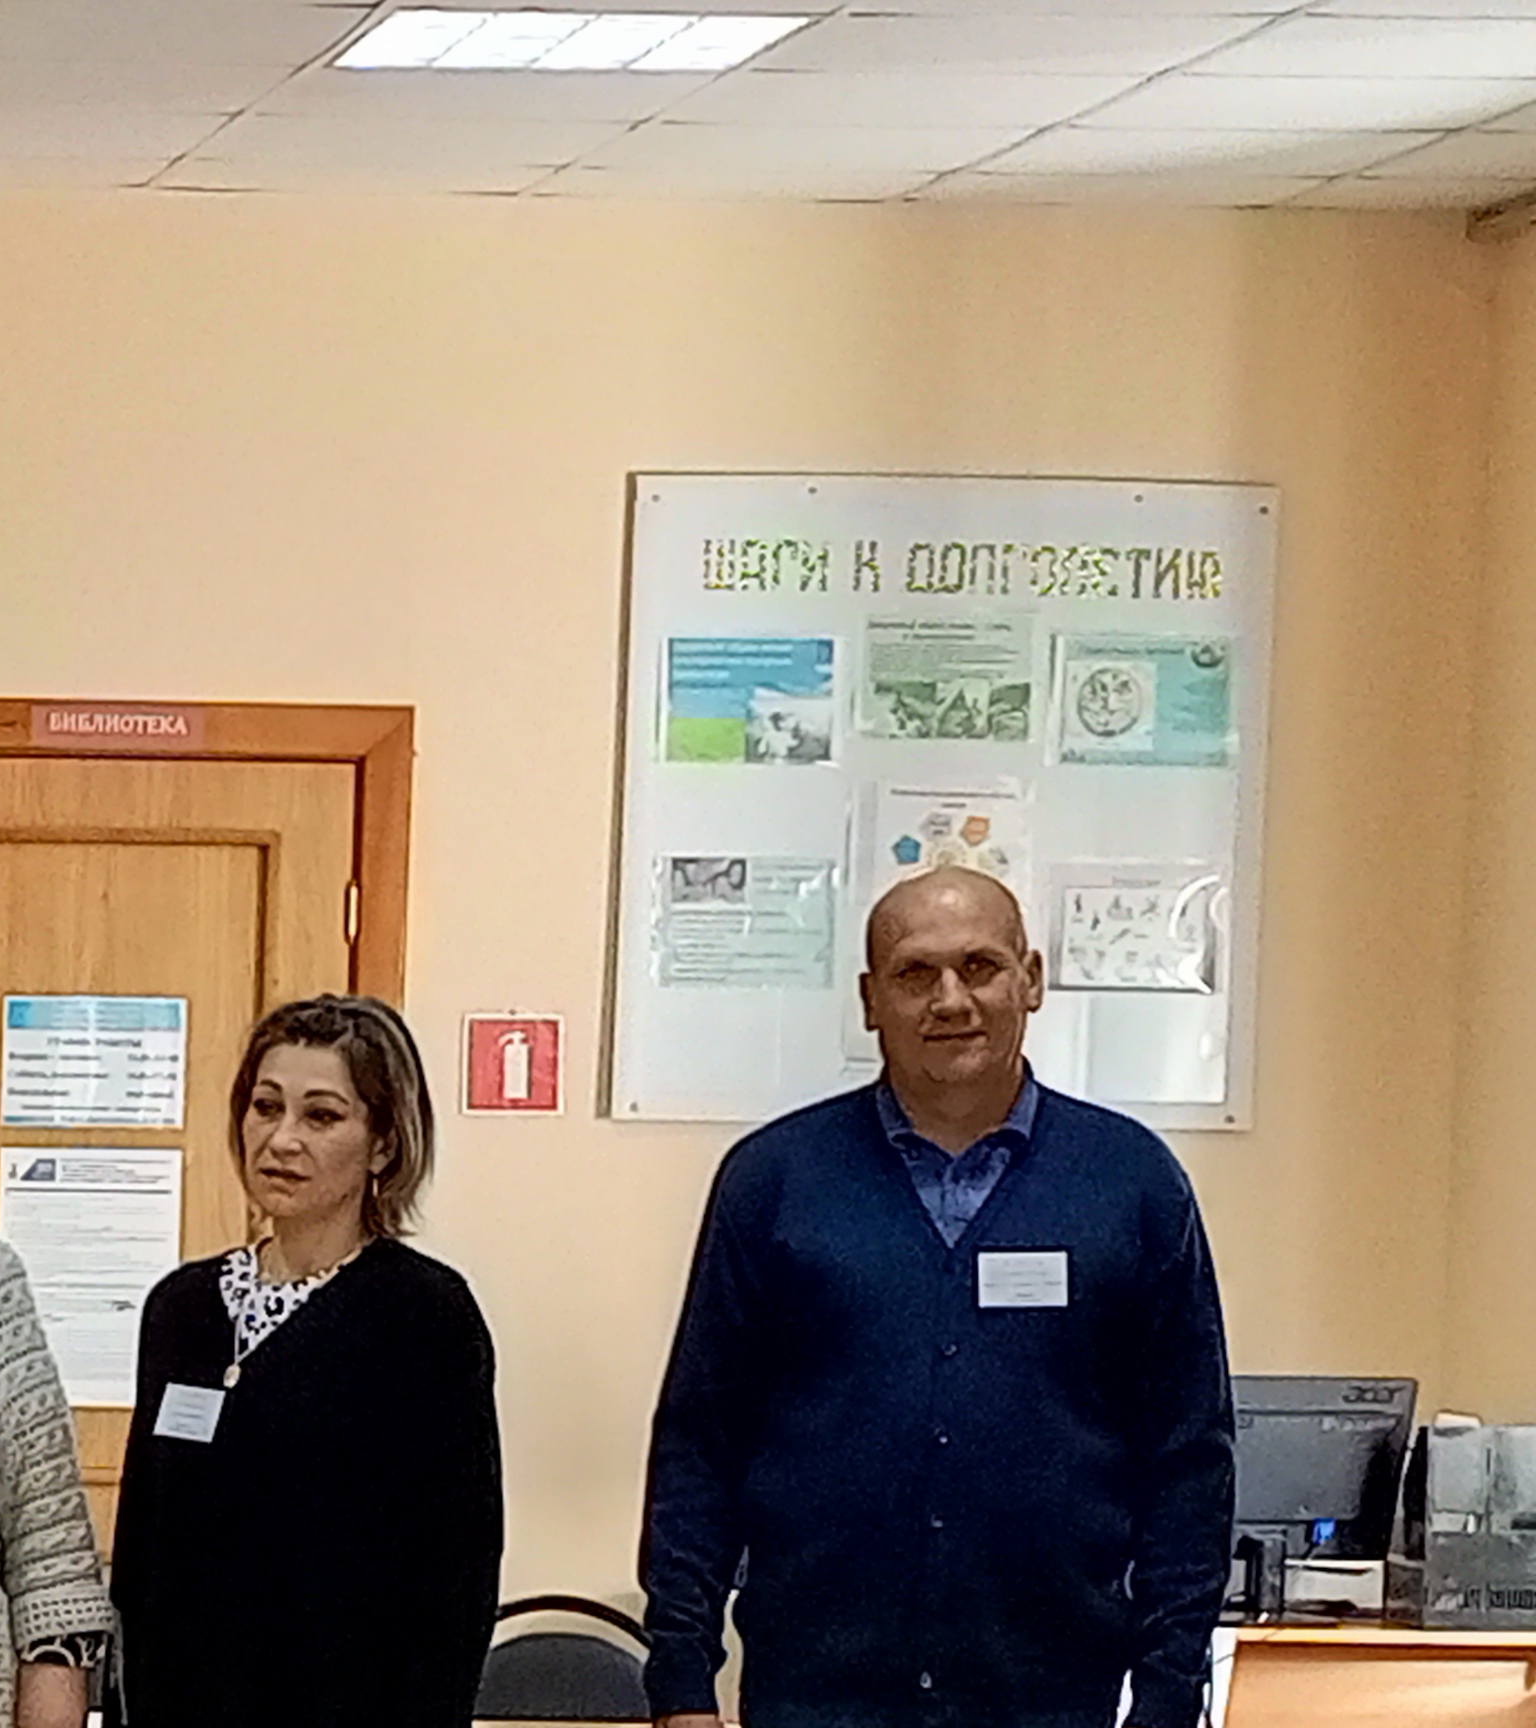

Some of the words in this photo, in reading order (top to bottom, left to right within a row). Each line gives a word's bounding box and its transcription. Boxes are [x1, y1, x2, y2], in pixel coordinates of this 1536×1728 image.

[702, 538, 829, 593] ШАГИ
[852, 539, 882, 593] К
[904, 541, 1223, 600] ДОЛГОЛЕТИЮ
[47, 712, 189, 737] БИБЛИОТЕКА
